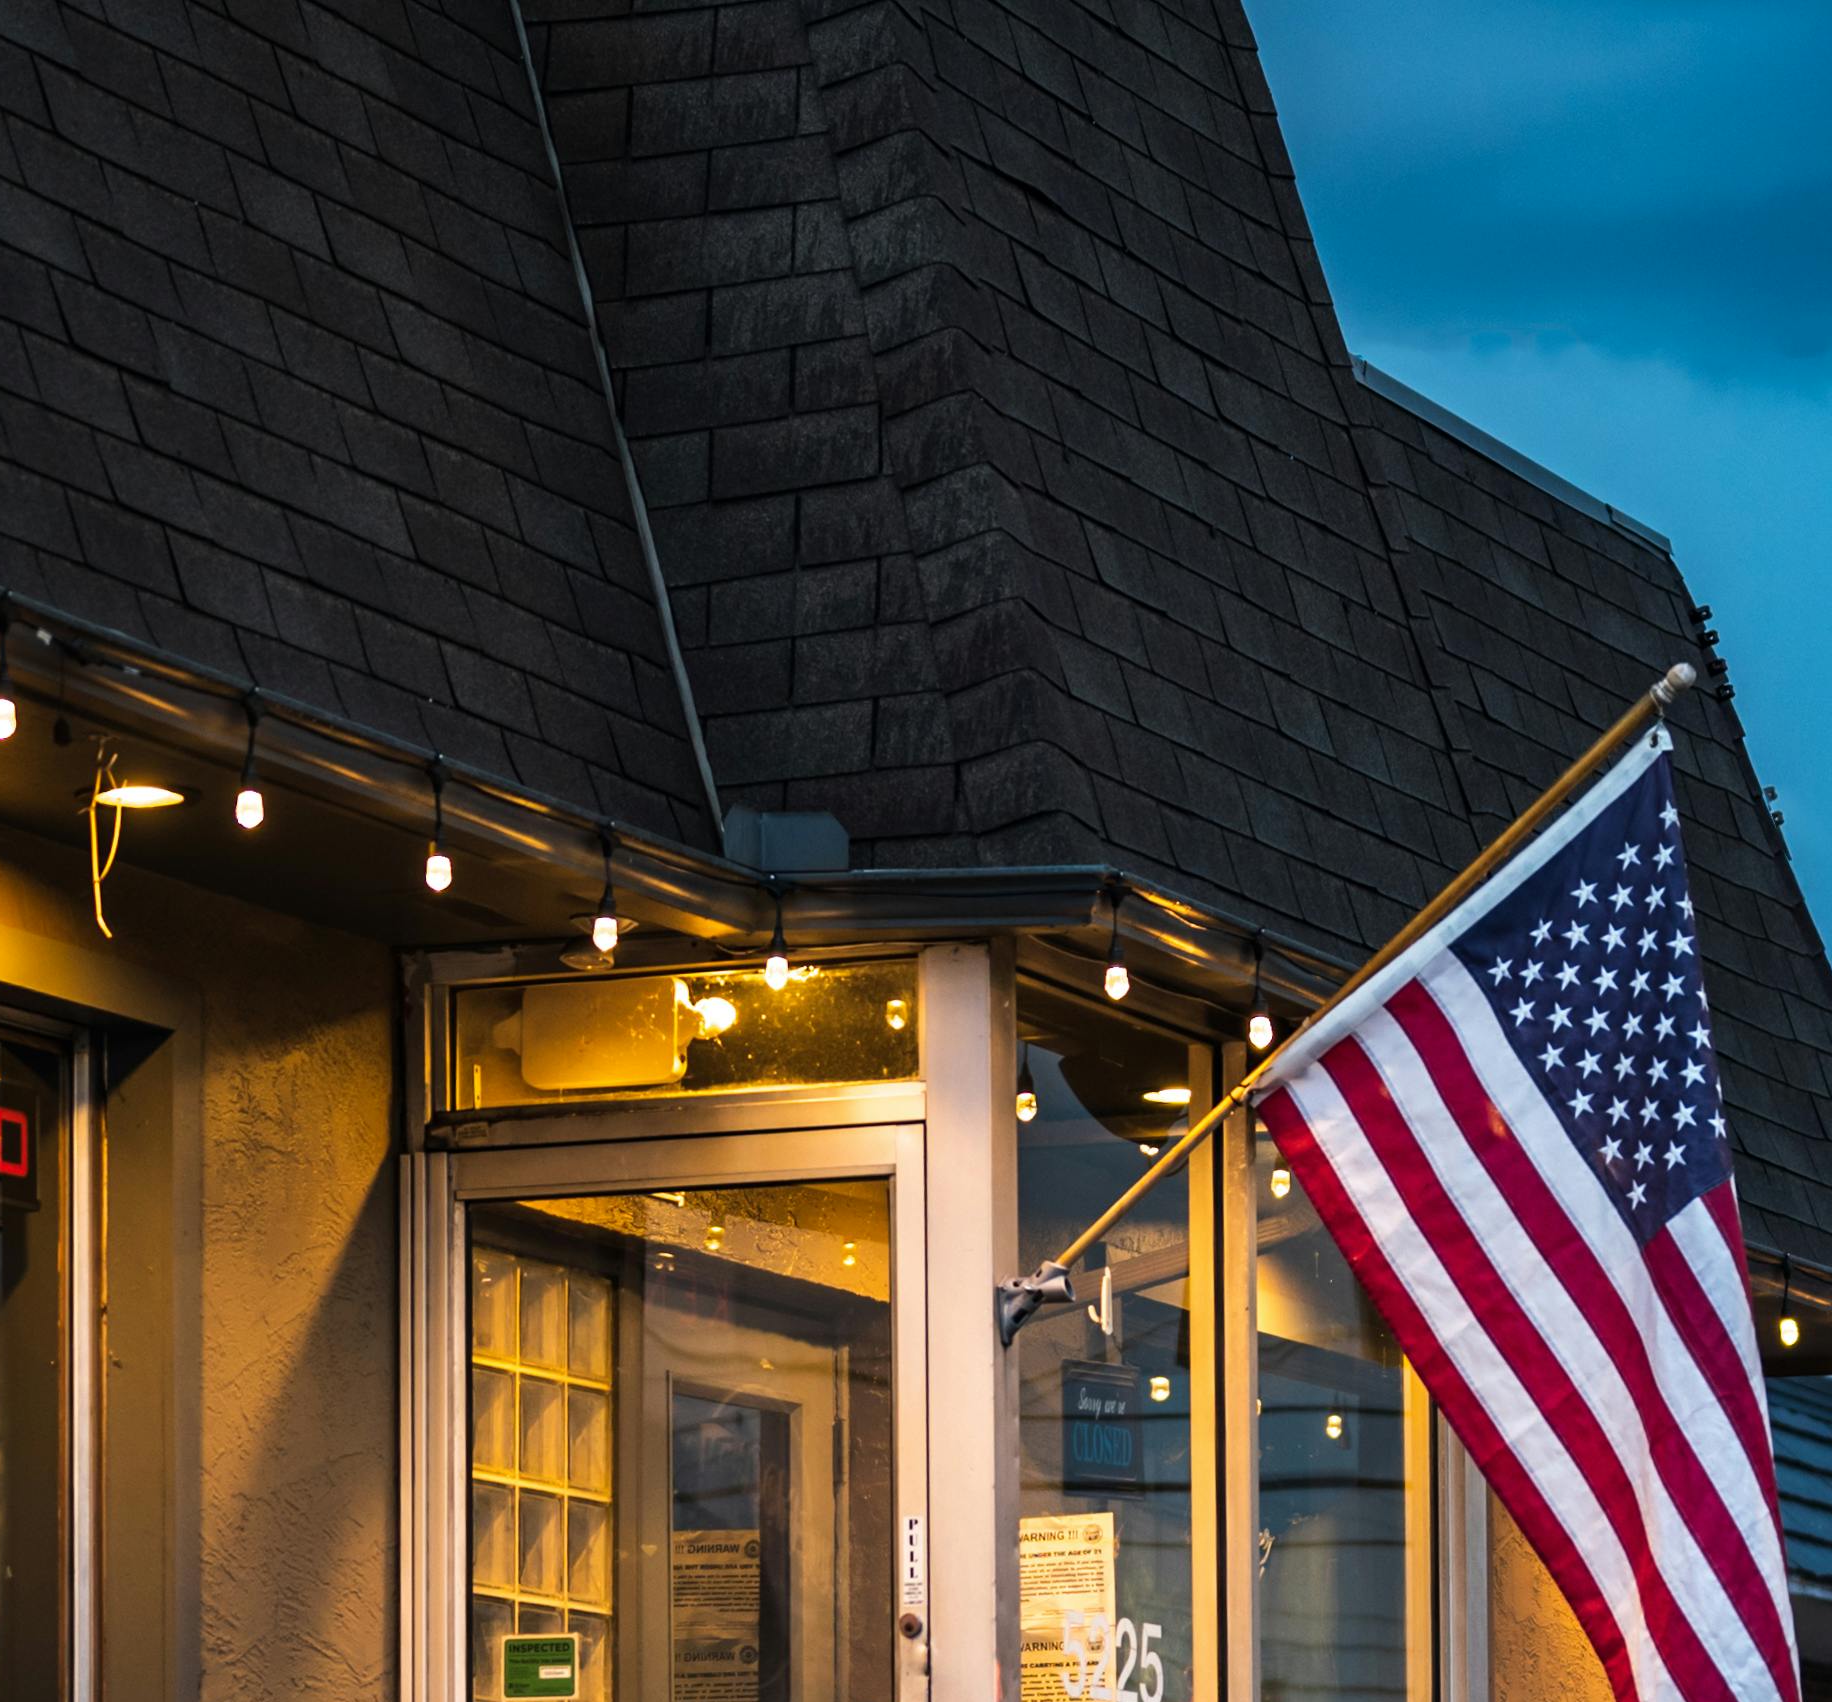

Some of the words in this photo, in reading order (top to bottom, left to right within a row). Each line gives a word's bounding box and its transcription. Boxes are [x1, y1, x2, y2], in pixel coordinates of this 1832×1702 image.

[1078, 1387, 1102, 1421] Sorry
[1072, 1421, 1133, 1467] CLOSED
[909, 1518, 919, 1579] PULL
[508, 1642, 570, 1653] INSPECTED
